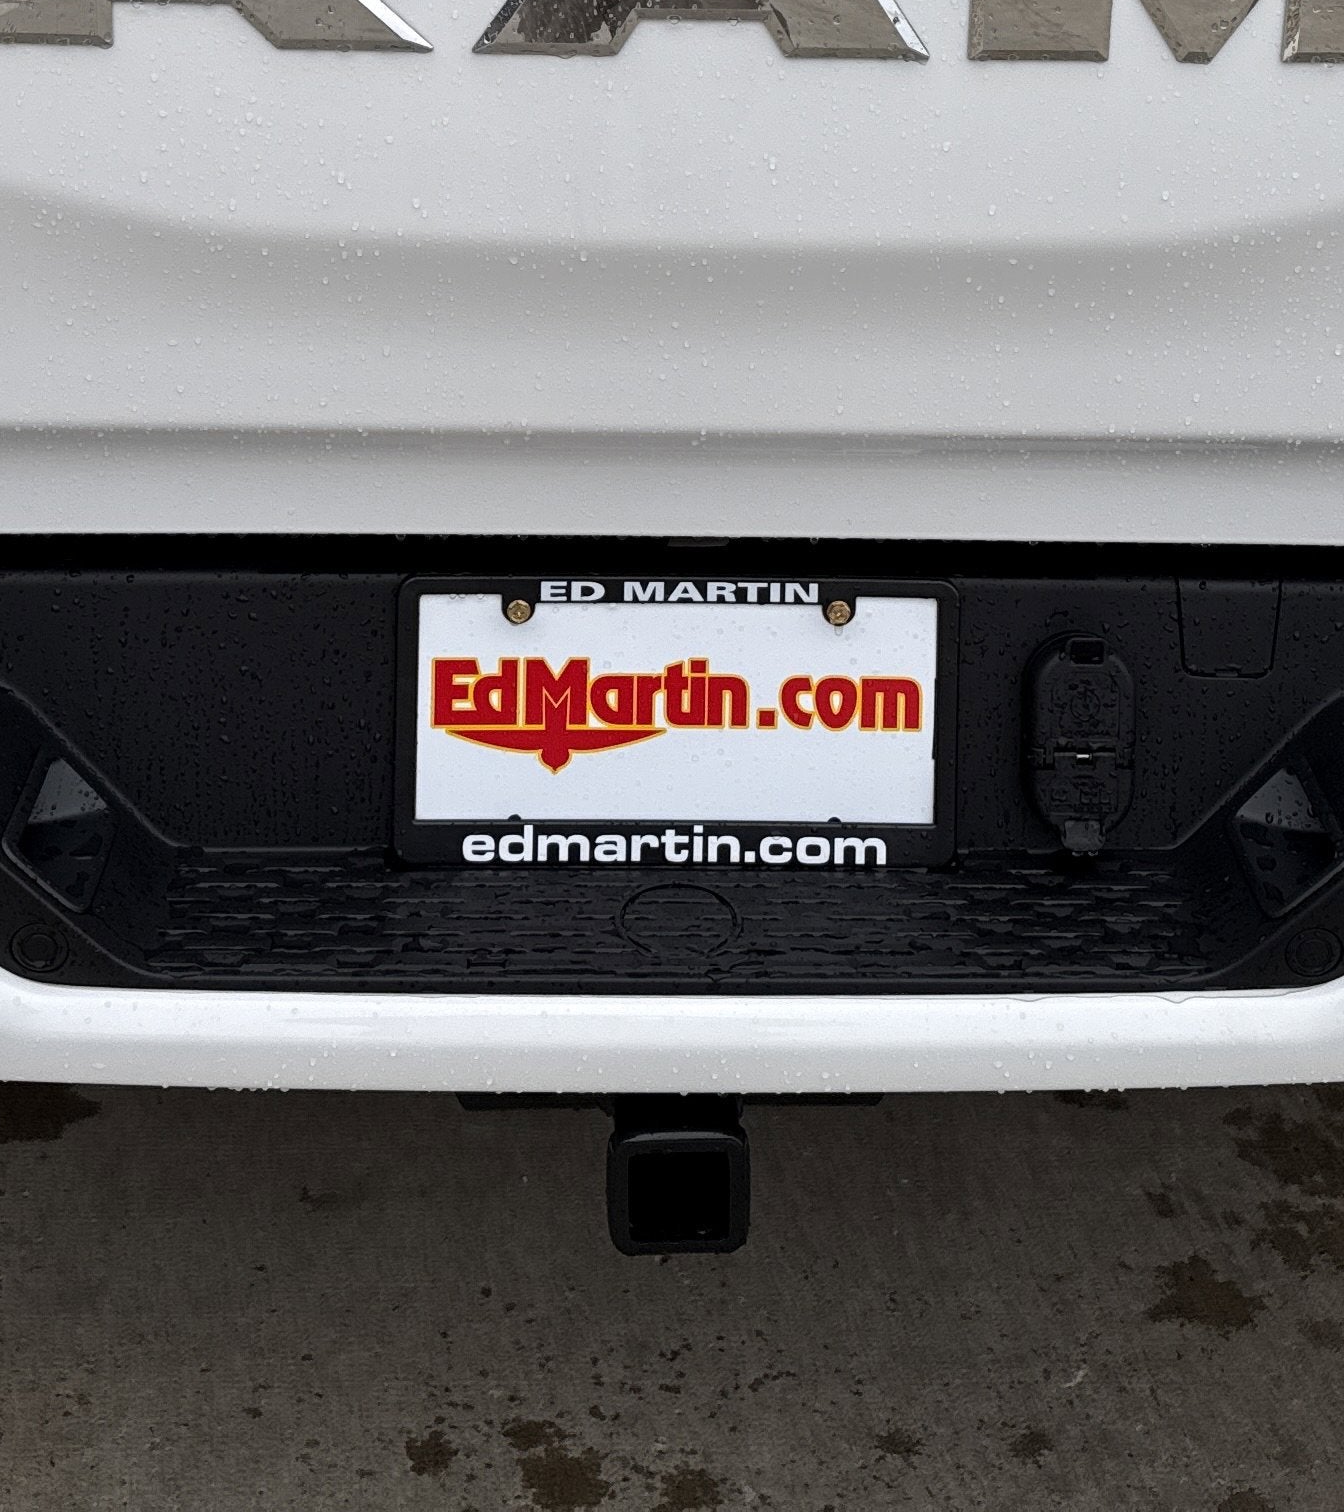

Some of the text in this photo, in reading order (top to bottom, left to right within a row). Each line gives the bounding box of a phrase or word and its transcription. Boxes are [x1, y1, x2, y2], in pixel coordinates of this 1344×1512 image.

[540, 580, 819, 604] ED MARTIN
[430, 656, 923, 733] EdMartin.com
[461, 824, 887, 865] edmartin.com
